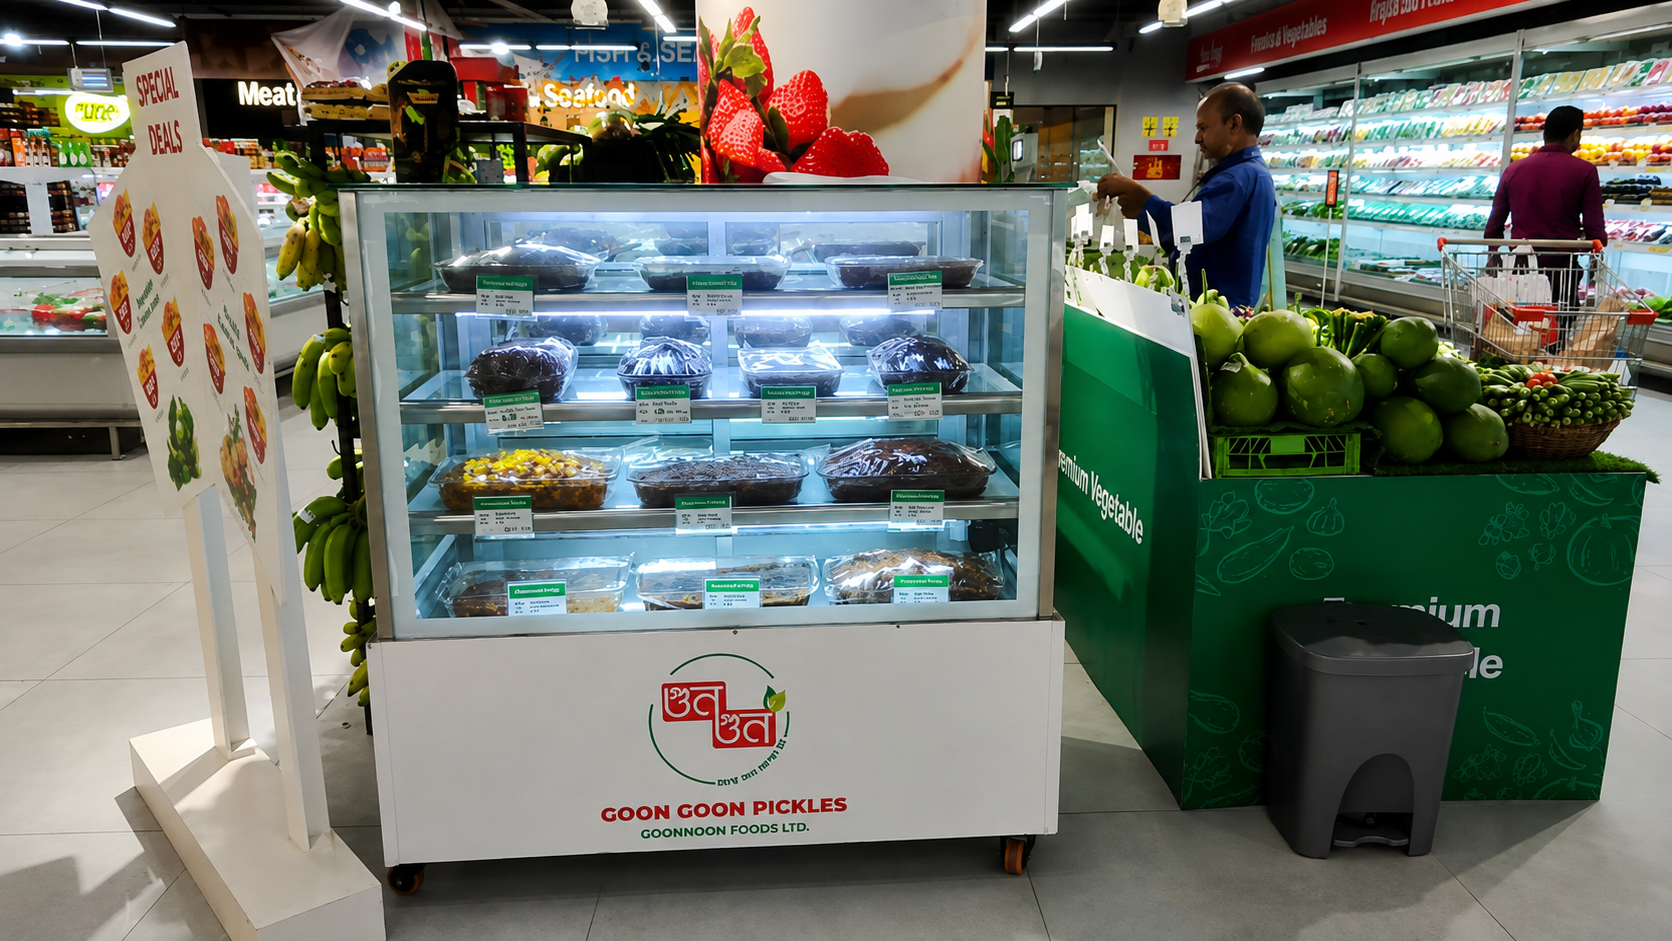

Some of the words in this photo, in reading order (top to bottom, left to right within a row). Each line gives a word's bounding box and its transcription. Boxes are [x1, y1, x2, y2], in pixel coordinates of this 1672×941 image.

[1283, 14, 1328, 48] Vegetables
[660, 42, 698, 63] SE
[136, 66, 180, 107] SPECIAL
[237, 81, 297, 106] Meat
[543, 83, 636, 108] Seafood
[147, 119, 183, 155] DEALS
[1058, 448, 1089, 496] remium
[1090, 470, 1144, 545] Vegetable
[600, 805, 670, 822] GOON
[677, 801, 745, 819] GOON
[753, 797, 848, 816] PICKLES
[640, 825, 726, 839] GOONNOON
[730, 823, 778, 836] FOODS
[782, 822, 810, 834] LTD.
